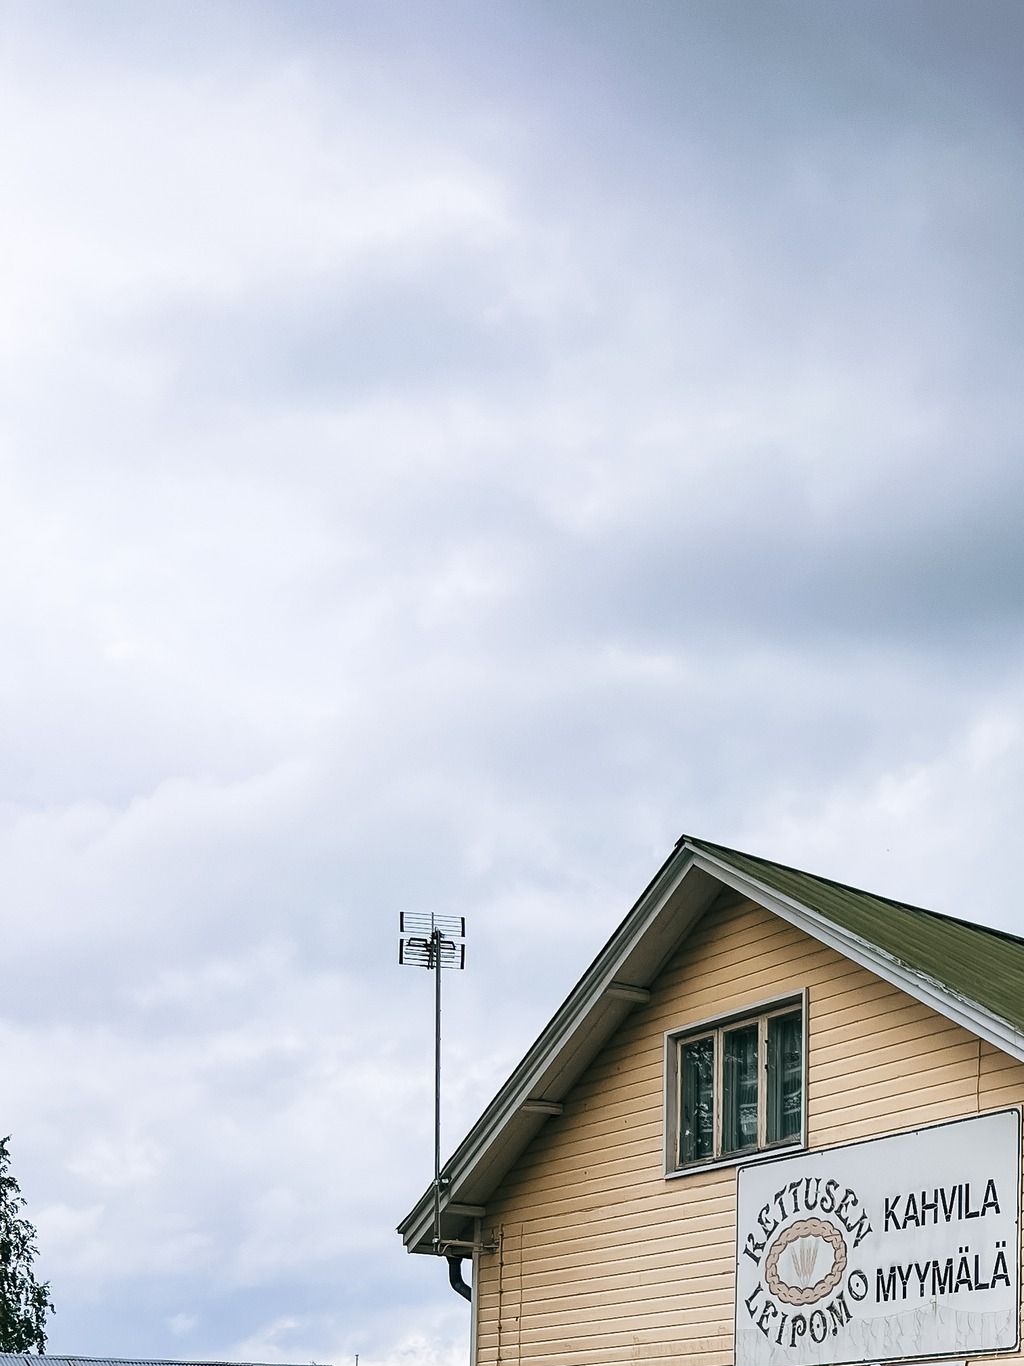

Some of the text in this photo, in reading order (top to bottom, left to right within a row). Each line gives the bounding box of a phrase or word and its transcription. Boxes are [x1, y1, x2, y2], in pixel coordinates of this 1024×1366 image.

[742, 1176, 873, 1267] KETTUSEN
[883, 1178, 1001, 1232] KAHVILA
[875, 1241, 1011, 1303] MYYMÄLÄ
[744, 1268, 869, 1348] LEIPOMO
